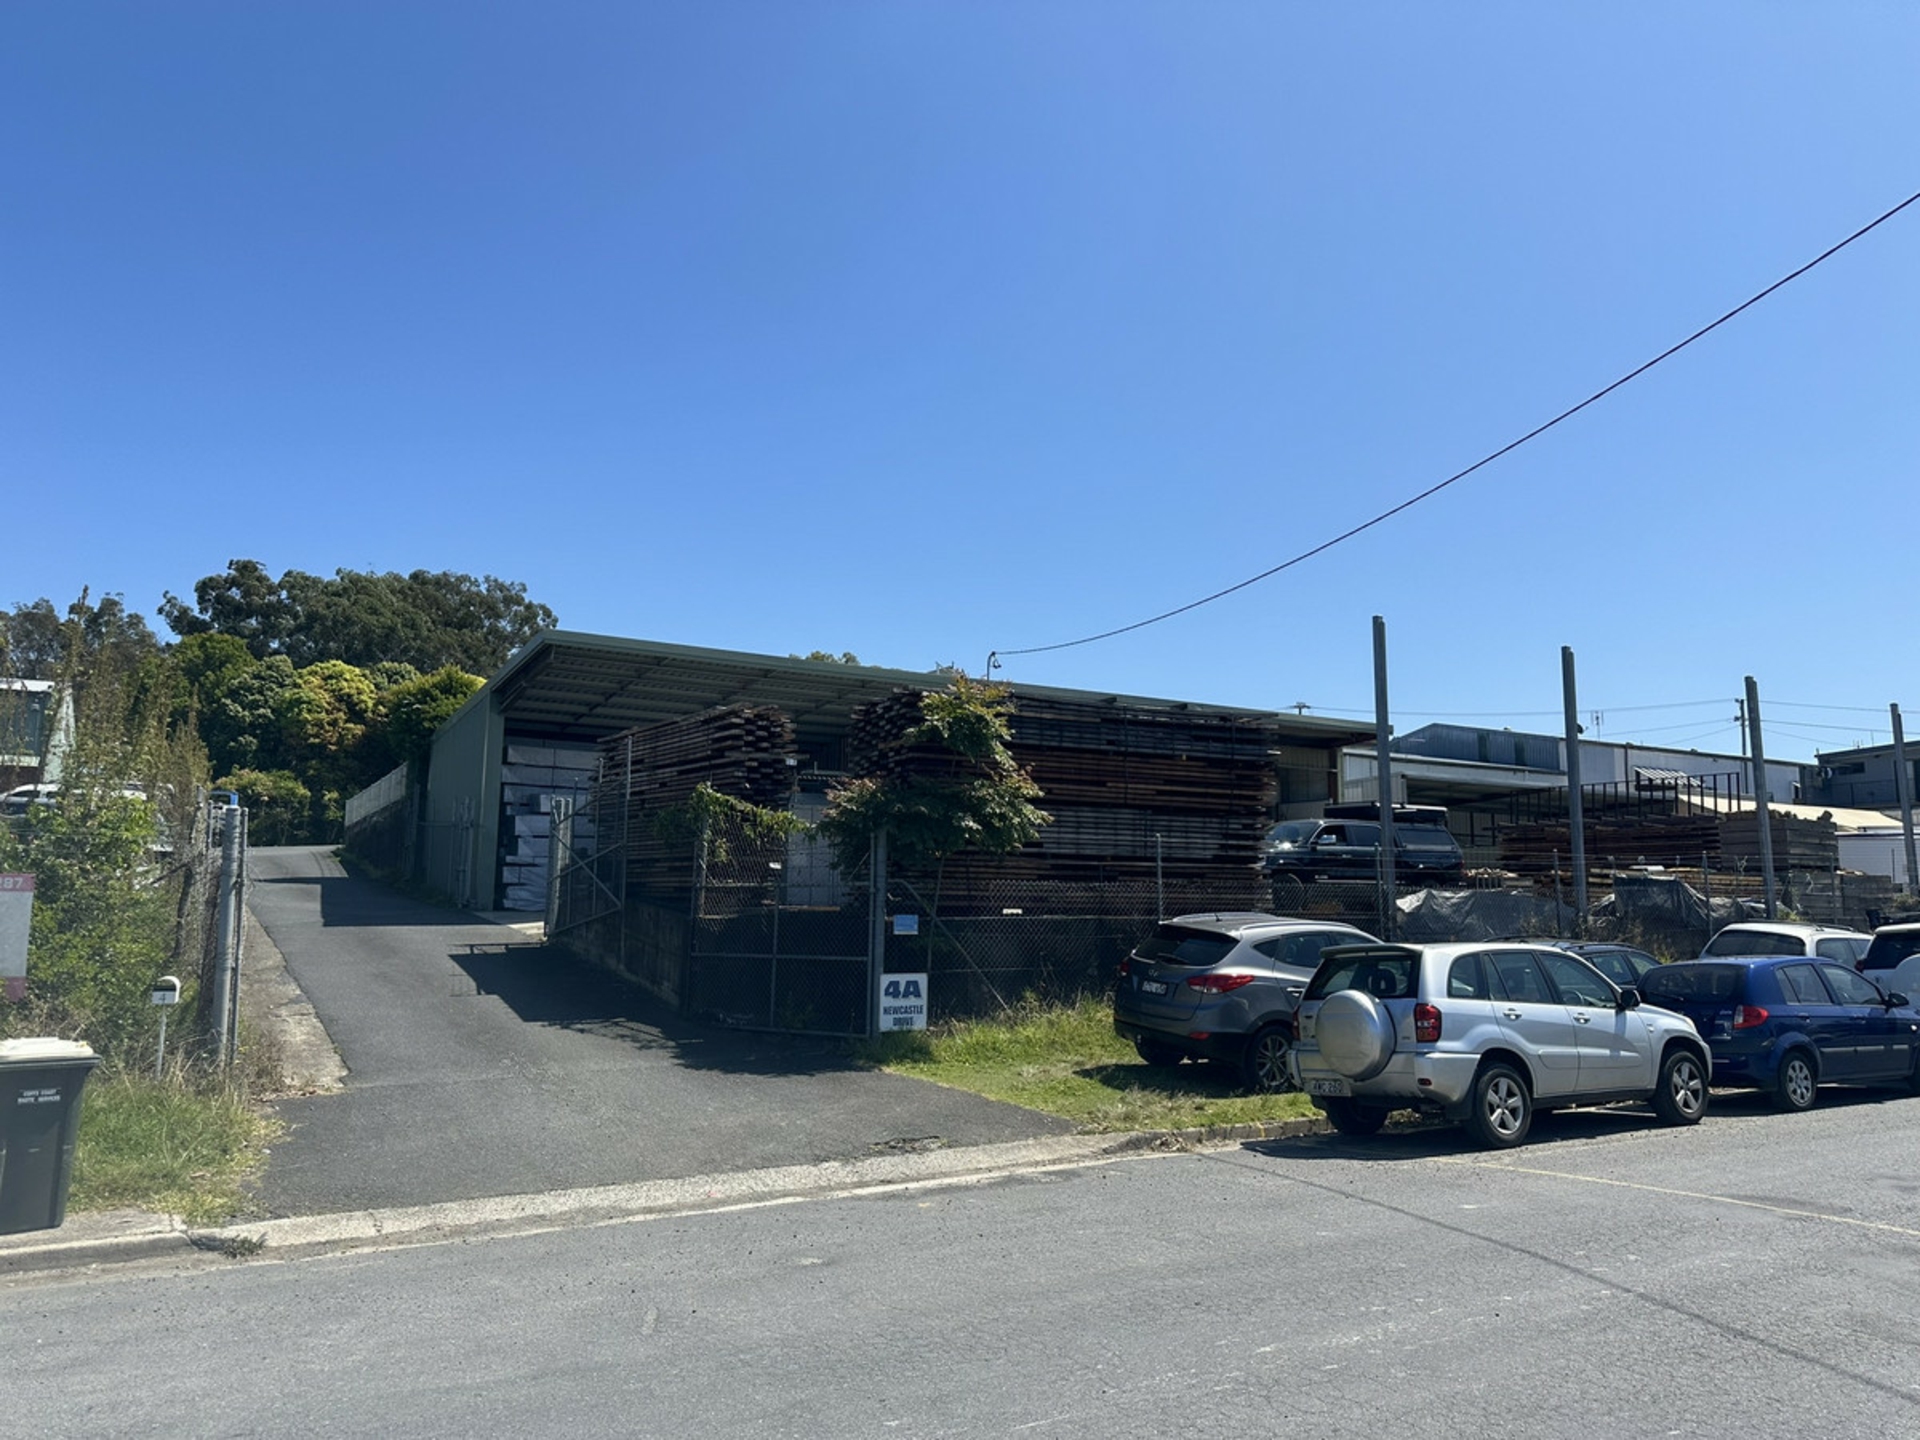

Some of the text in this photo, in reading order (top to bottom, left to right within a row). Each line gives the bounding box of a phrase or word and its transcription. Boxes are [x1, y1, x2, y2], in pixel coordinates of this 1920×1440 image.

[0, 876, 23, 889] 87
[884, 980, 922, 999] 4A
[883, 1004, 924, 1015] NEWCASTLE
